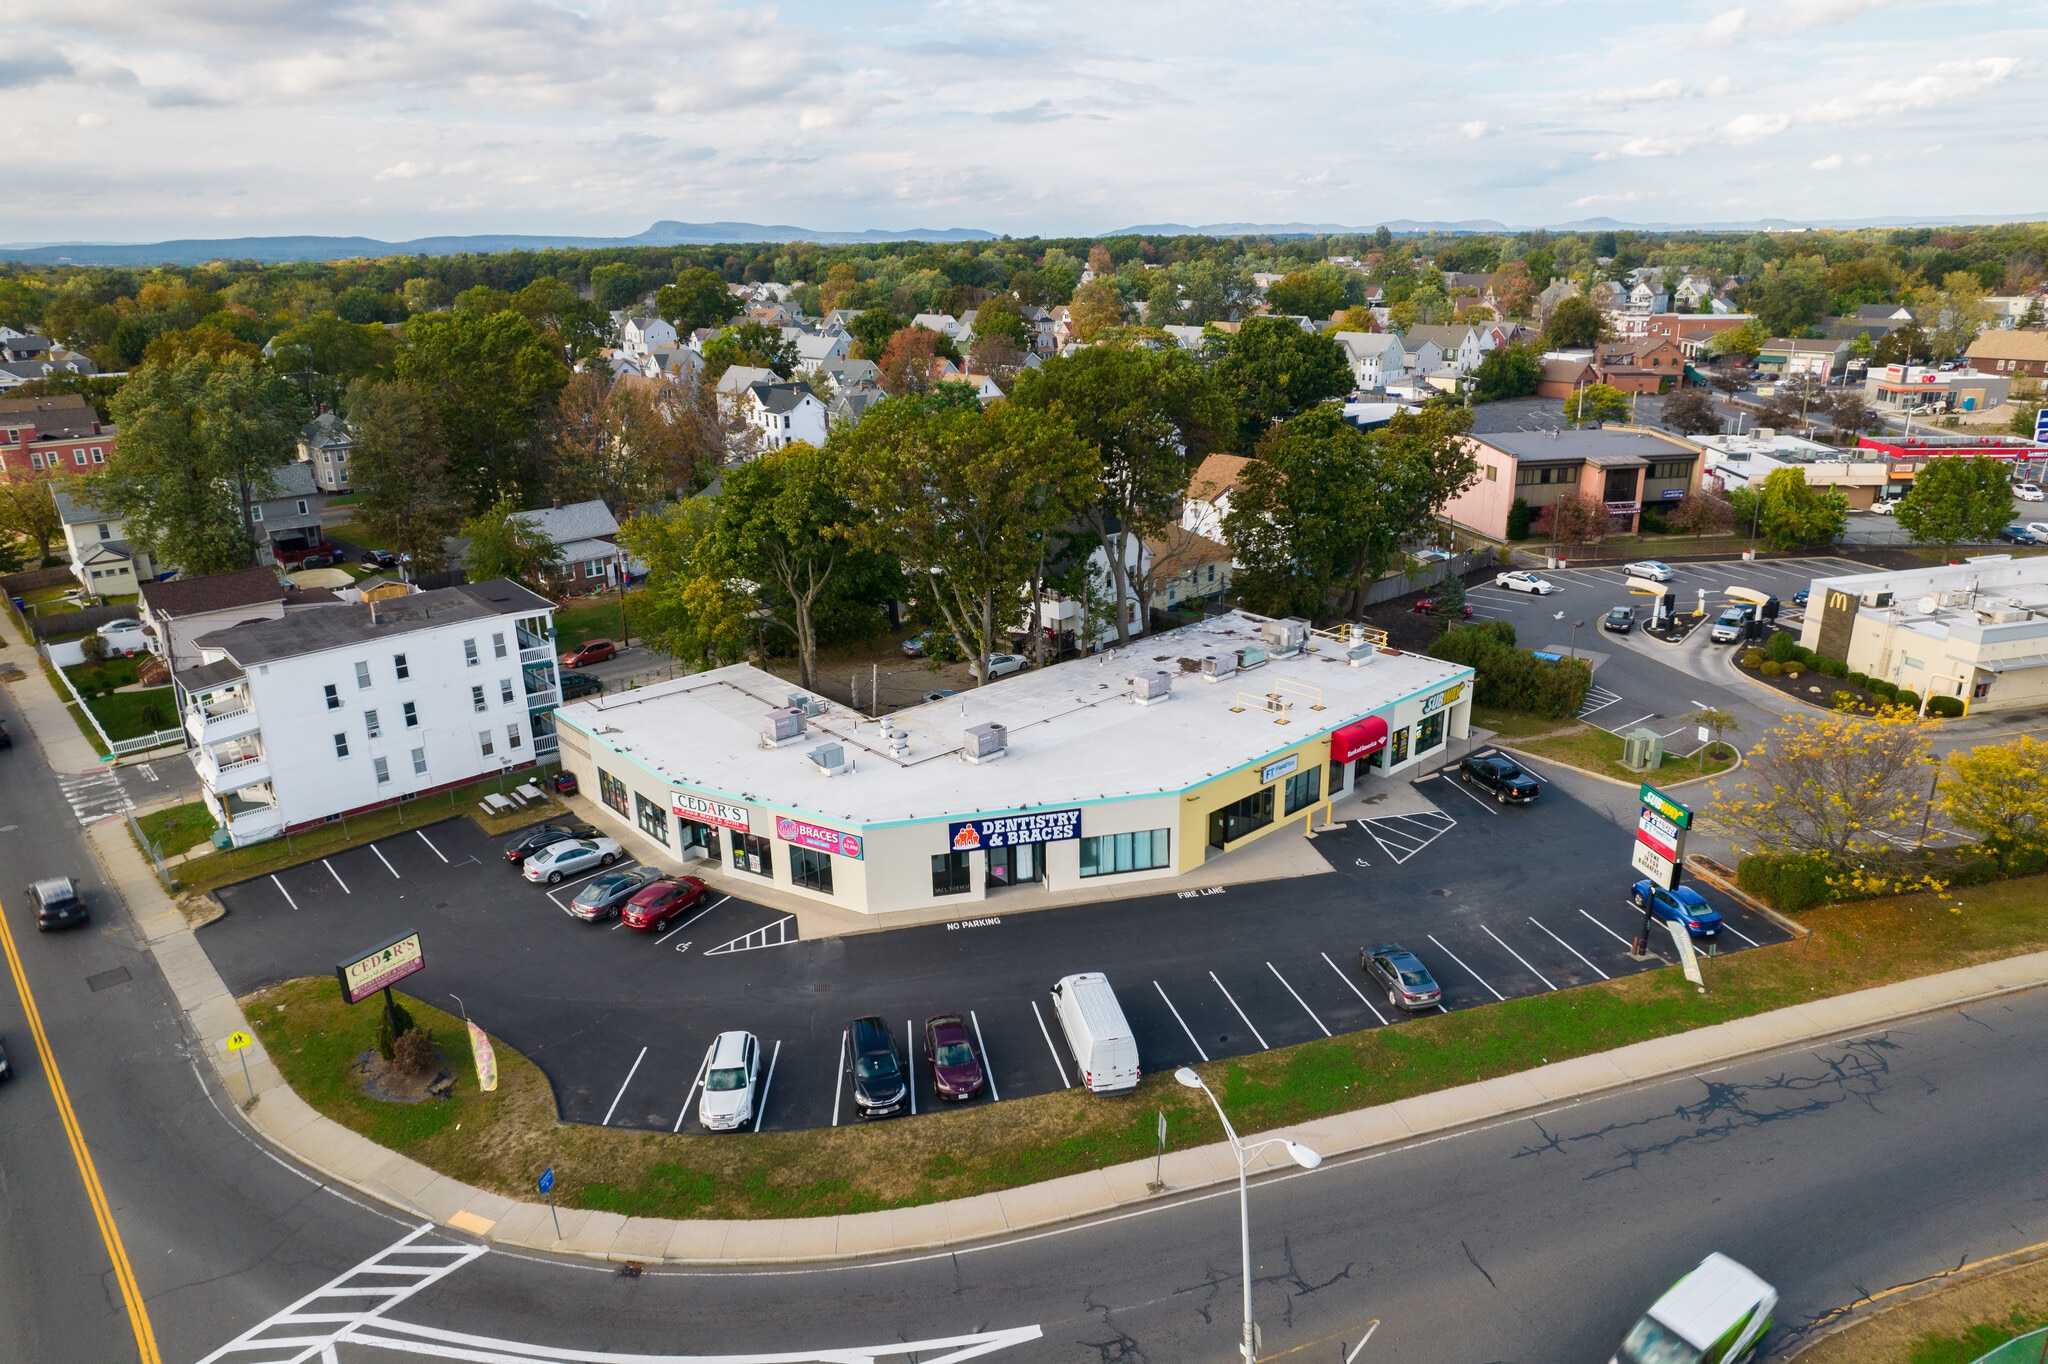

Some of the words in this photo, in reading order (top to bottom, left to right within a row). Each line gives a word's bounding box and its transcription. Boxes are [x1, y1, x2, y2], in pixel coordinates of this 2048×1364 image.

[1423, 682, 1465, 714] SUBWAY
[1266, 768, 1275, 779] FT
[678, 795, 742, 820] CEDAR'S
[681, 809, 698, 817] Food
[700, 812, 715, 820] Mart
[1644, 792, 1684, 820] SUBWAY
[981, 811, 1079, 835] DENTISTRY
[799, 825, 839, 843] BRACES
[989, 833, 1003, 847] &
[1007, 825, 1074, 845] BRACES
[1647, 851, 1659, 862] COME
[1650, 858, 1659, 868] FOR
[1638, 857, 1663, 878] BREAKFAST
[1177, 890, 1199, 899] FIRE
[1200, 886, 1226, 896] LANE
[947, 922, 960, 931] NO
[961, 917, 1001, 929] PARKING
